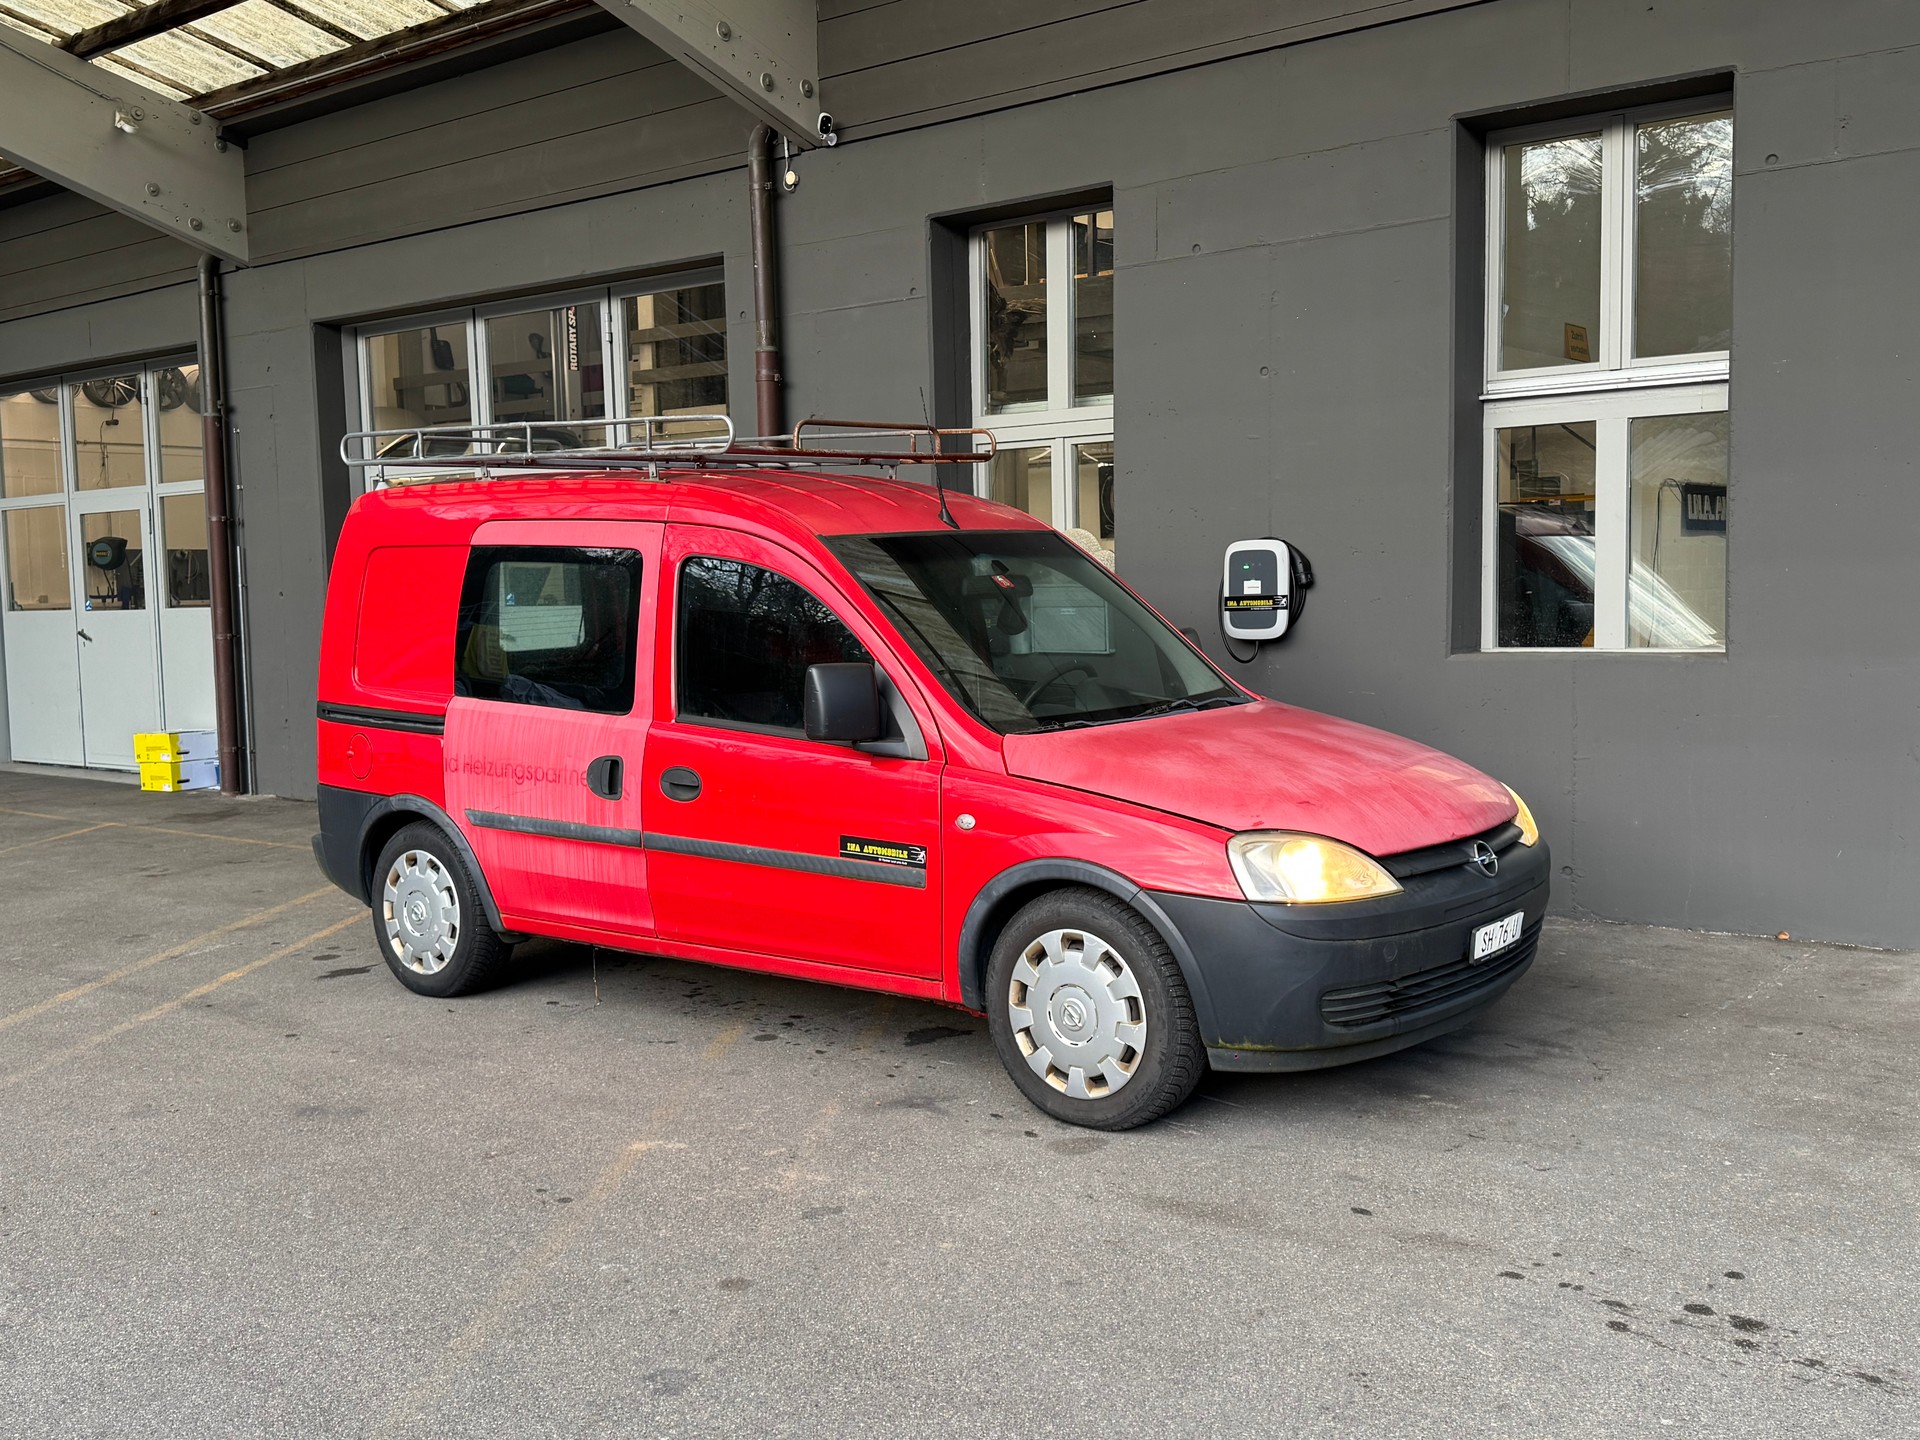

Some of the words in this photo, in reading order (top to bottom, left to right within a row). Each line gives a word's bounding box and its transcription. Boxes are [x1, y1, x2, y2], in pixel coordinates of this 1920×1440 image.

[568, 327, 578, 371] ROTARY
[846, 842, 861, 852] INA
[863, 844, 909, 859] AUTOMOBILE
